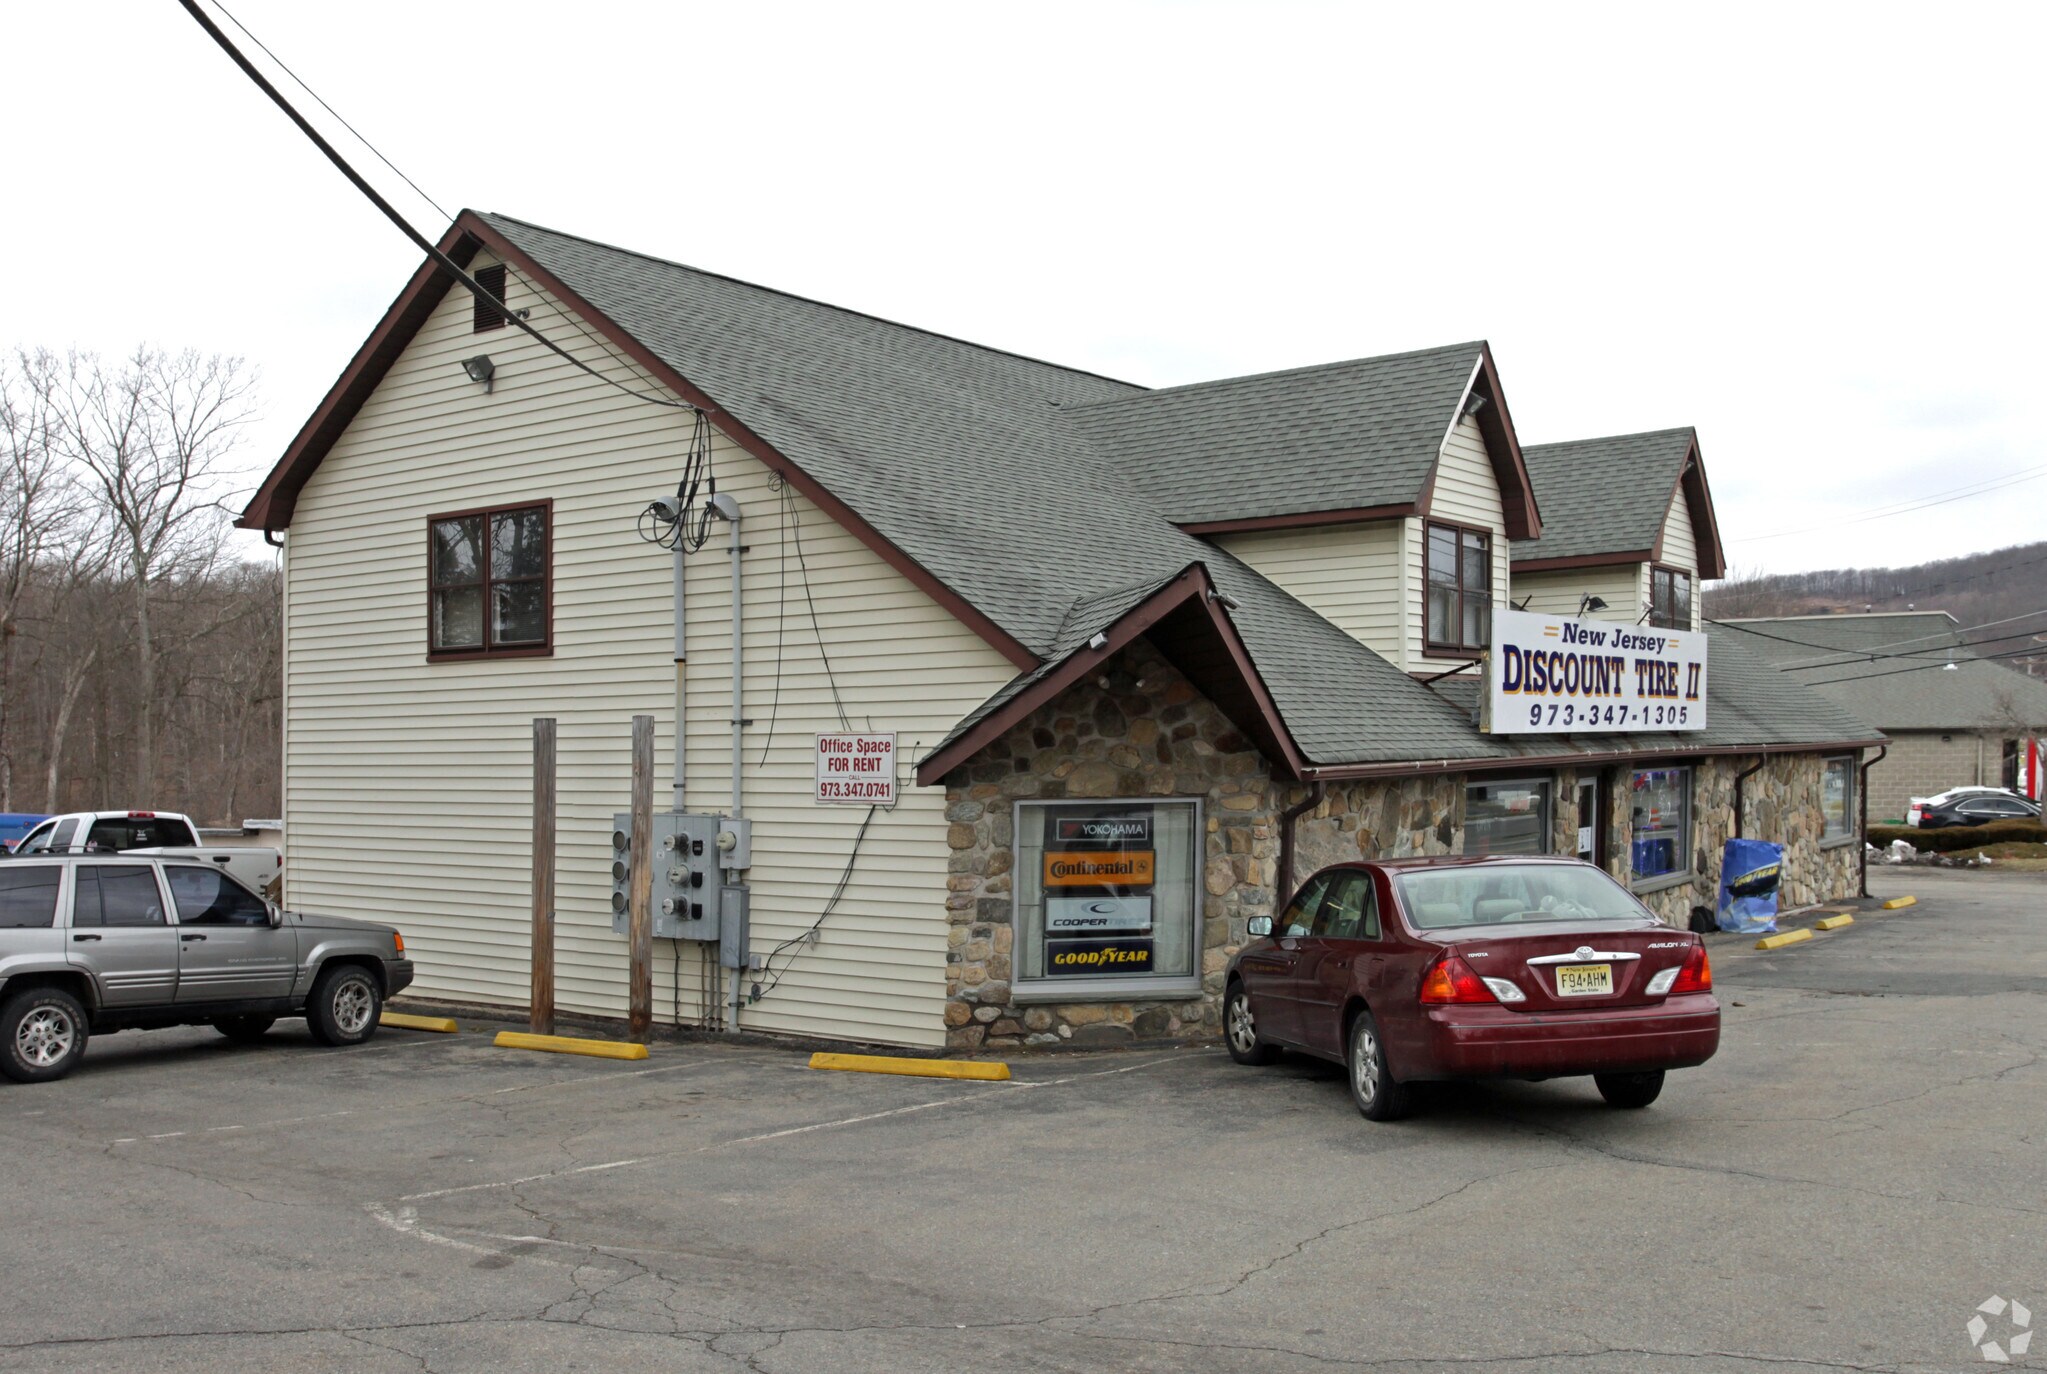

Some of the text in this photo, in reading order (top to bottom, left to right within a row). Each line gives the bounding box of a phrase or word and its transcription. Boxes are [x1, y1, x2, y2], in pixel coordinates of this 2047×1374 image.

[1562, 622, 1666, 655] New Jersey
[1502, 643, 1626, 698] DISCOUNT
[1634, 658, 1679, 700] TIRE
[820, 738, 891, 756] Office Space
[828, 757, 882, 772] FOR RENT
[820, 782, 890, 798] 973.347.0741
[1082, 823, 1144, 836] YOKOHAMA
[1050, 859, 1134, 879] Continental
[1053, 918, 1108, 927] COOPER
[1054, 947, 1149, 966] GOODYEAR
